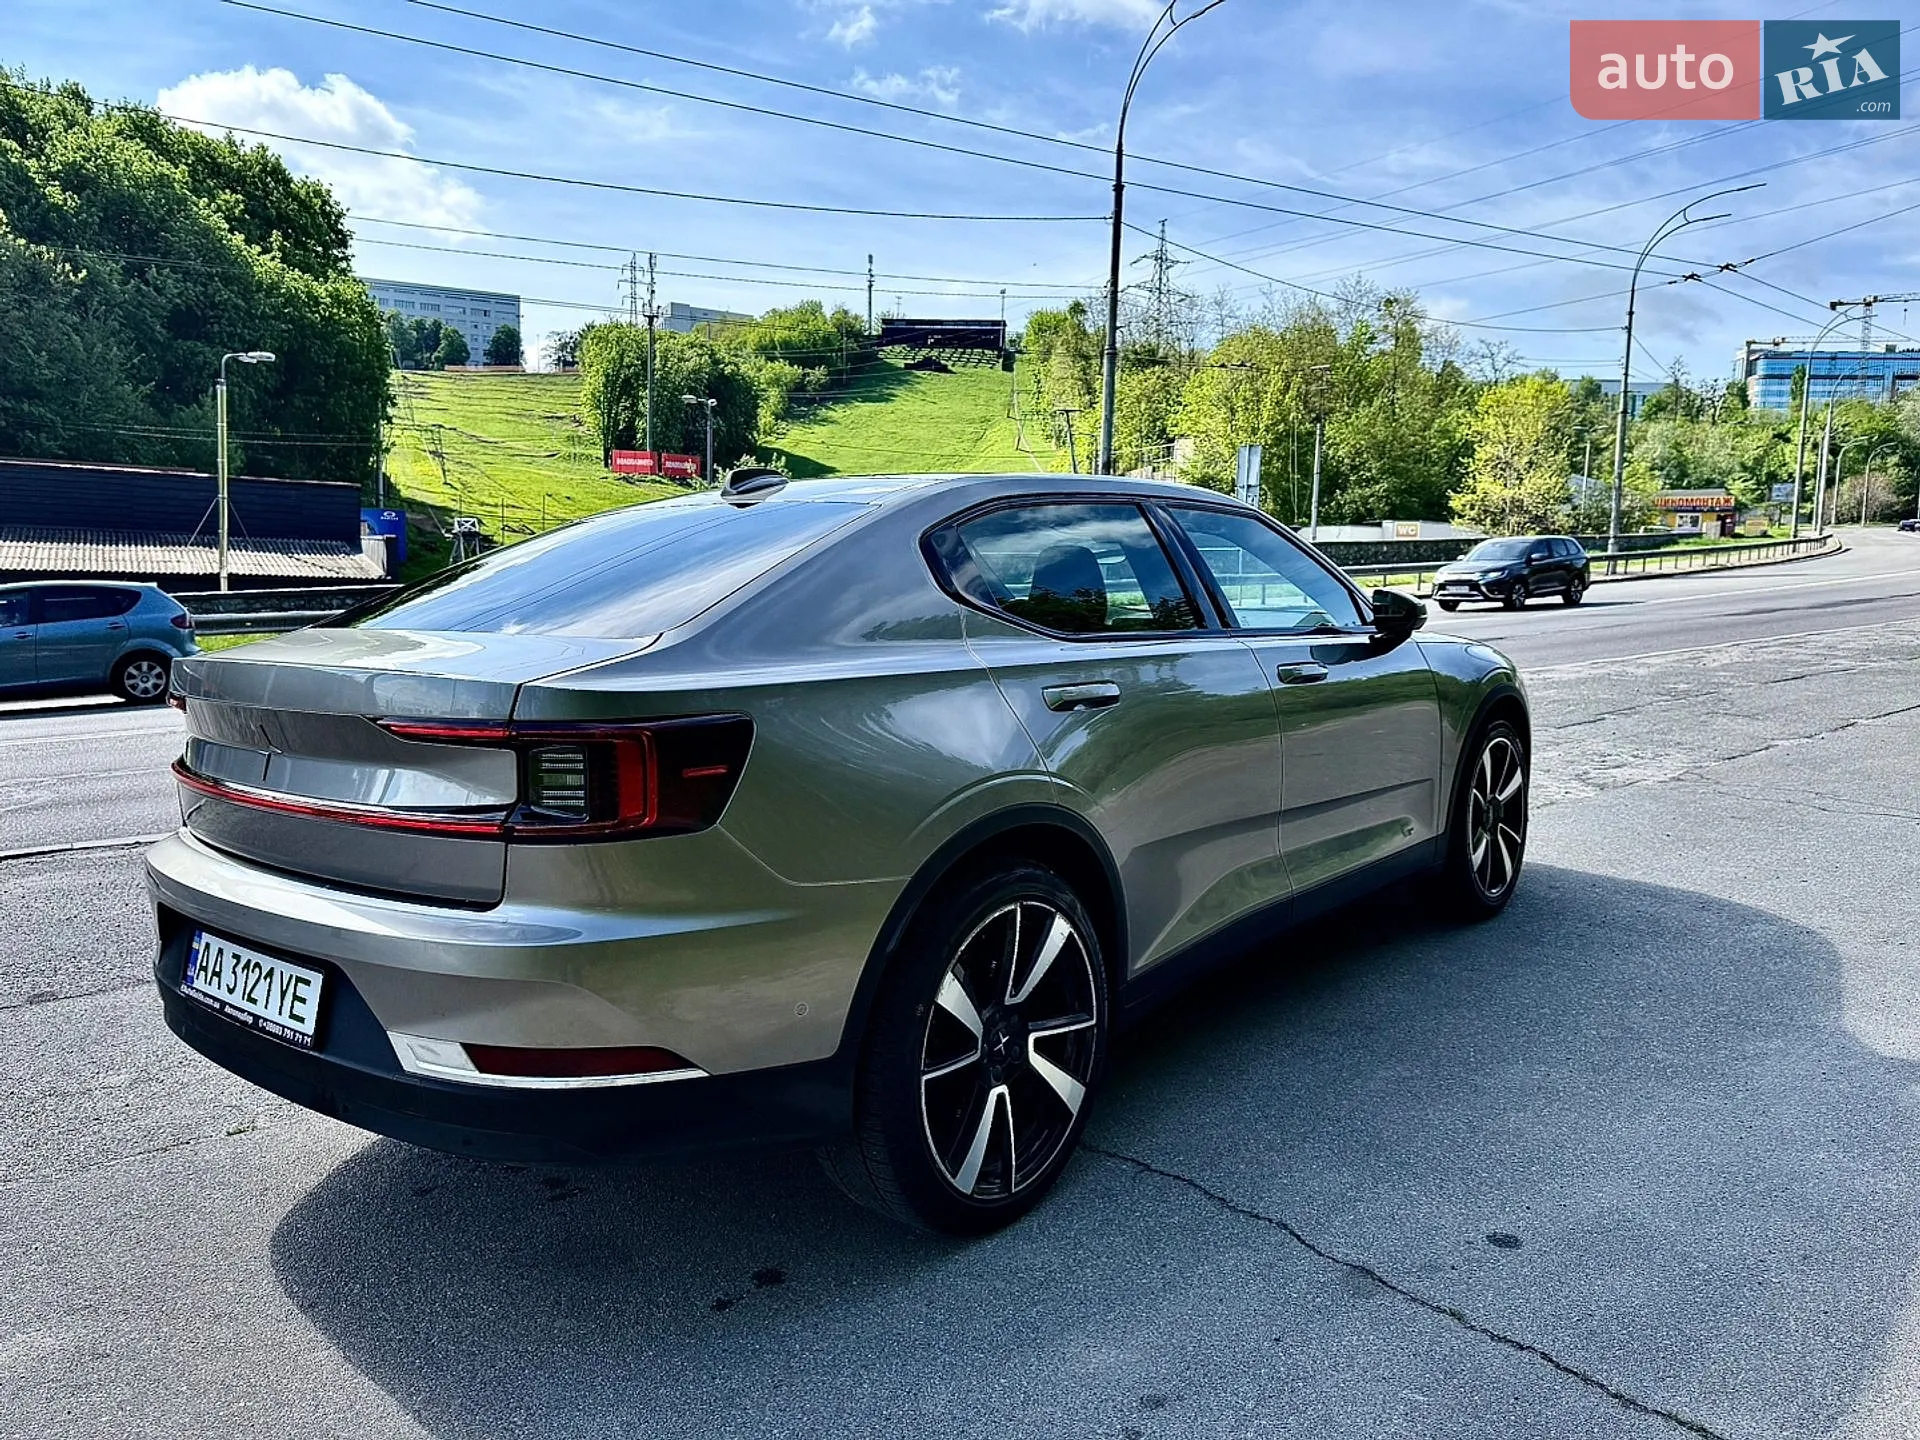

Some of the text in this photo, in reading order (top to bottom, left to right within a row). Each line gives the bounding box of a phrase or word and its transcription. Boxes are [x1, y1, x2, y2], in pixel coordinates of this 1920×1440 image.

[1398, 525, 1416, 535] WC
[196, 941, 224, 990] AA
[226, 952, 275, 1010] 3121
[278, 970, 311, 1024] YE
